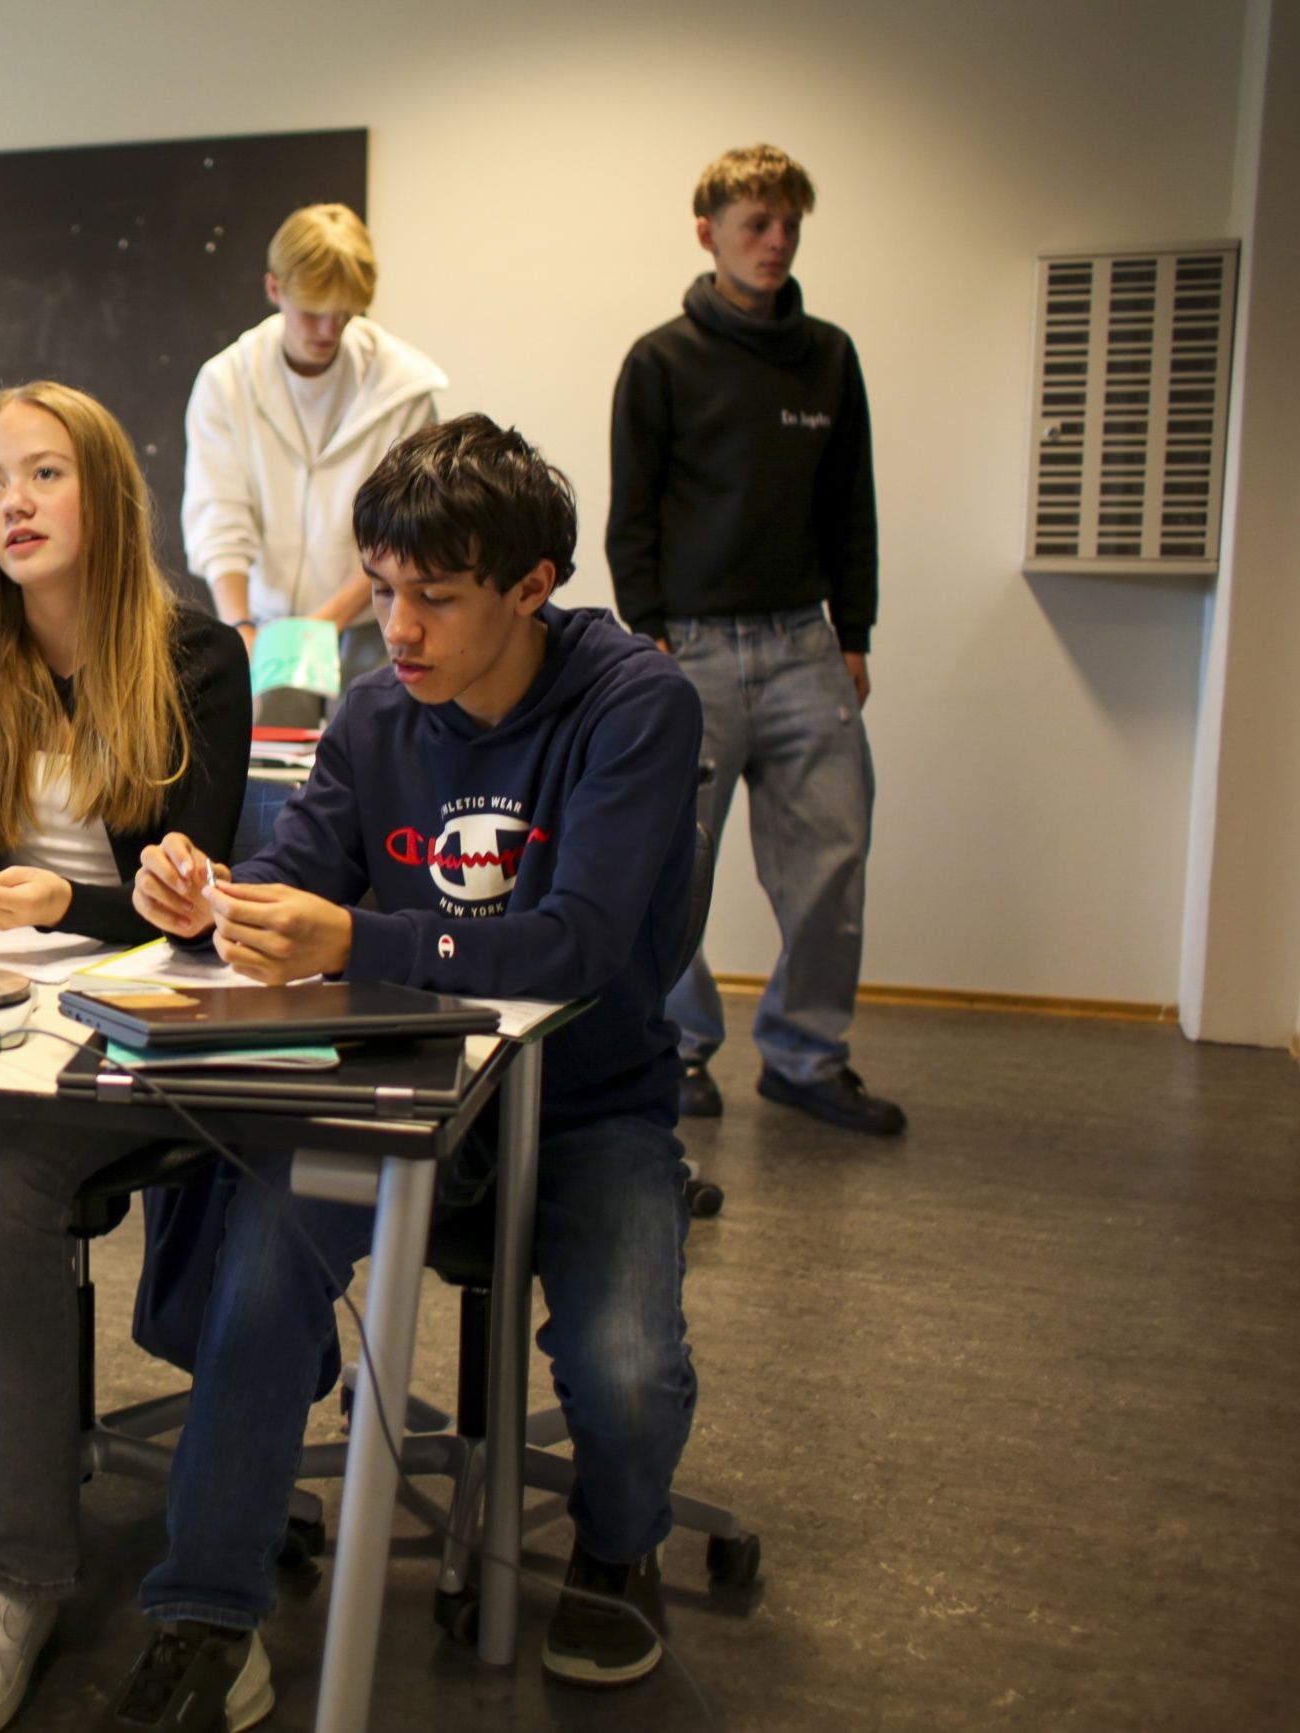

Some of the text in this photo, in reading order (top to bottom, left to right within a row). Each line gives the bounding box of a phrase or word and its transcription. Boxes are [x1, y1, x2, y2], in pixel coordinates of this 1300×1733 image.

[491, 796, 522, 814] WEAR
[439, 896, 504, 918] NEW YORK
